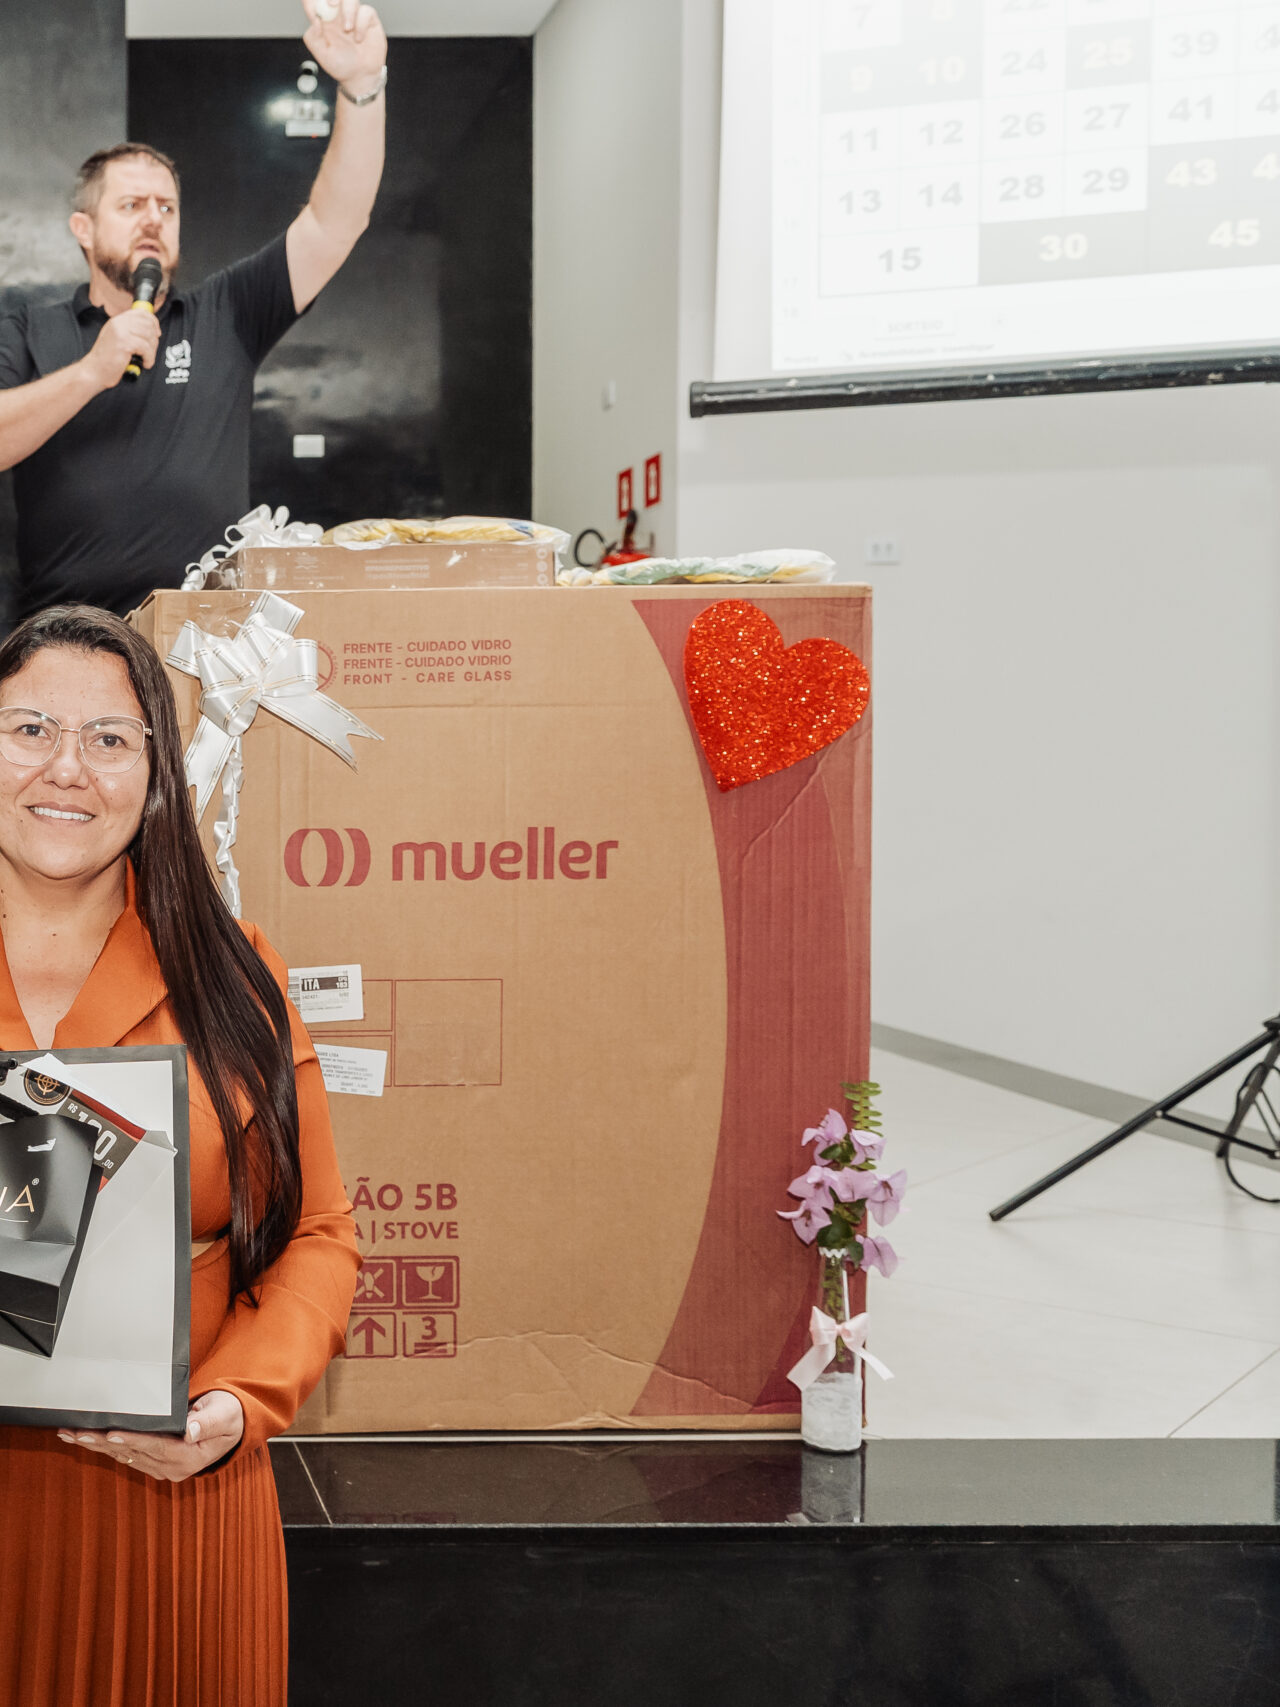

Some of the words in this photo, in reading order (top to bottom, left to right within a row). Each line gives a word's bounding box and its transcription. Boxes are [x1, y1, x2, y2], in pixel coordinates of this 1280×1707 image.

[849, 64, 874, 93] 9
[920, 55, 966, 85] 10
[1000, 48, 1048, 77] 24
[1083, 37, 1134, 70] 25
[1170, 29, 1219, 59] 39
[838, 127, 880, 154] 11
[919, 119, 965, 147] 12
[999, 111, 1047, 140] 26
[1082, 103, 1132, 132] 27
[1167, 95, 1215, 123] 41
[838, 188, 882, 216] 13
[917, 181, 964, 209] 14
[998, 174, 1046, 203] 28
[1081, 166, 1131, 196] 29
[1164, 158, 1218, 189] 43
[876, 246, 923, 274] 15
[1038, 232, 1090, 262] 30
[1208, 218, 1261, 249] 45
[344, 642, 392, 654] FRENTE
[407, 640, 467, 653] CUIDADO
[471, 639, 512, 651] VIDRO
[344, 658, 392, 670] FRENTE
[405, 655, 465, 668] CUIDADO
[468, 655, 512, 667] VIDRIO
[344, 673, 392, 685] FRONT
[416, 672, 455, 683] CARE
[464, 670, 512, 682] GLASS
[391, 826, 619, 881] mueller
[343, 1177, 403, 1211] ÃO
[415, 1183, 458, 1211] 5B
[384, 1221, 459, 1240] STOVE
[421, 1316, 437, 1340] 3
